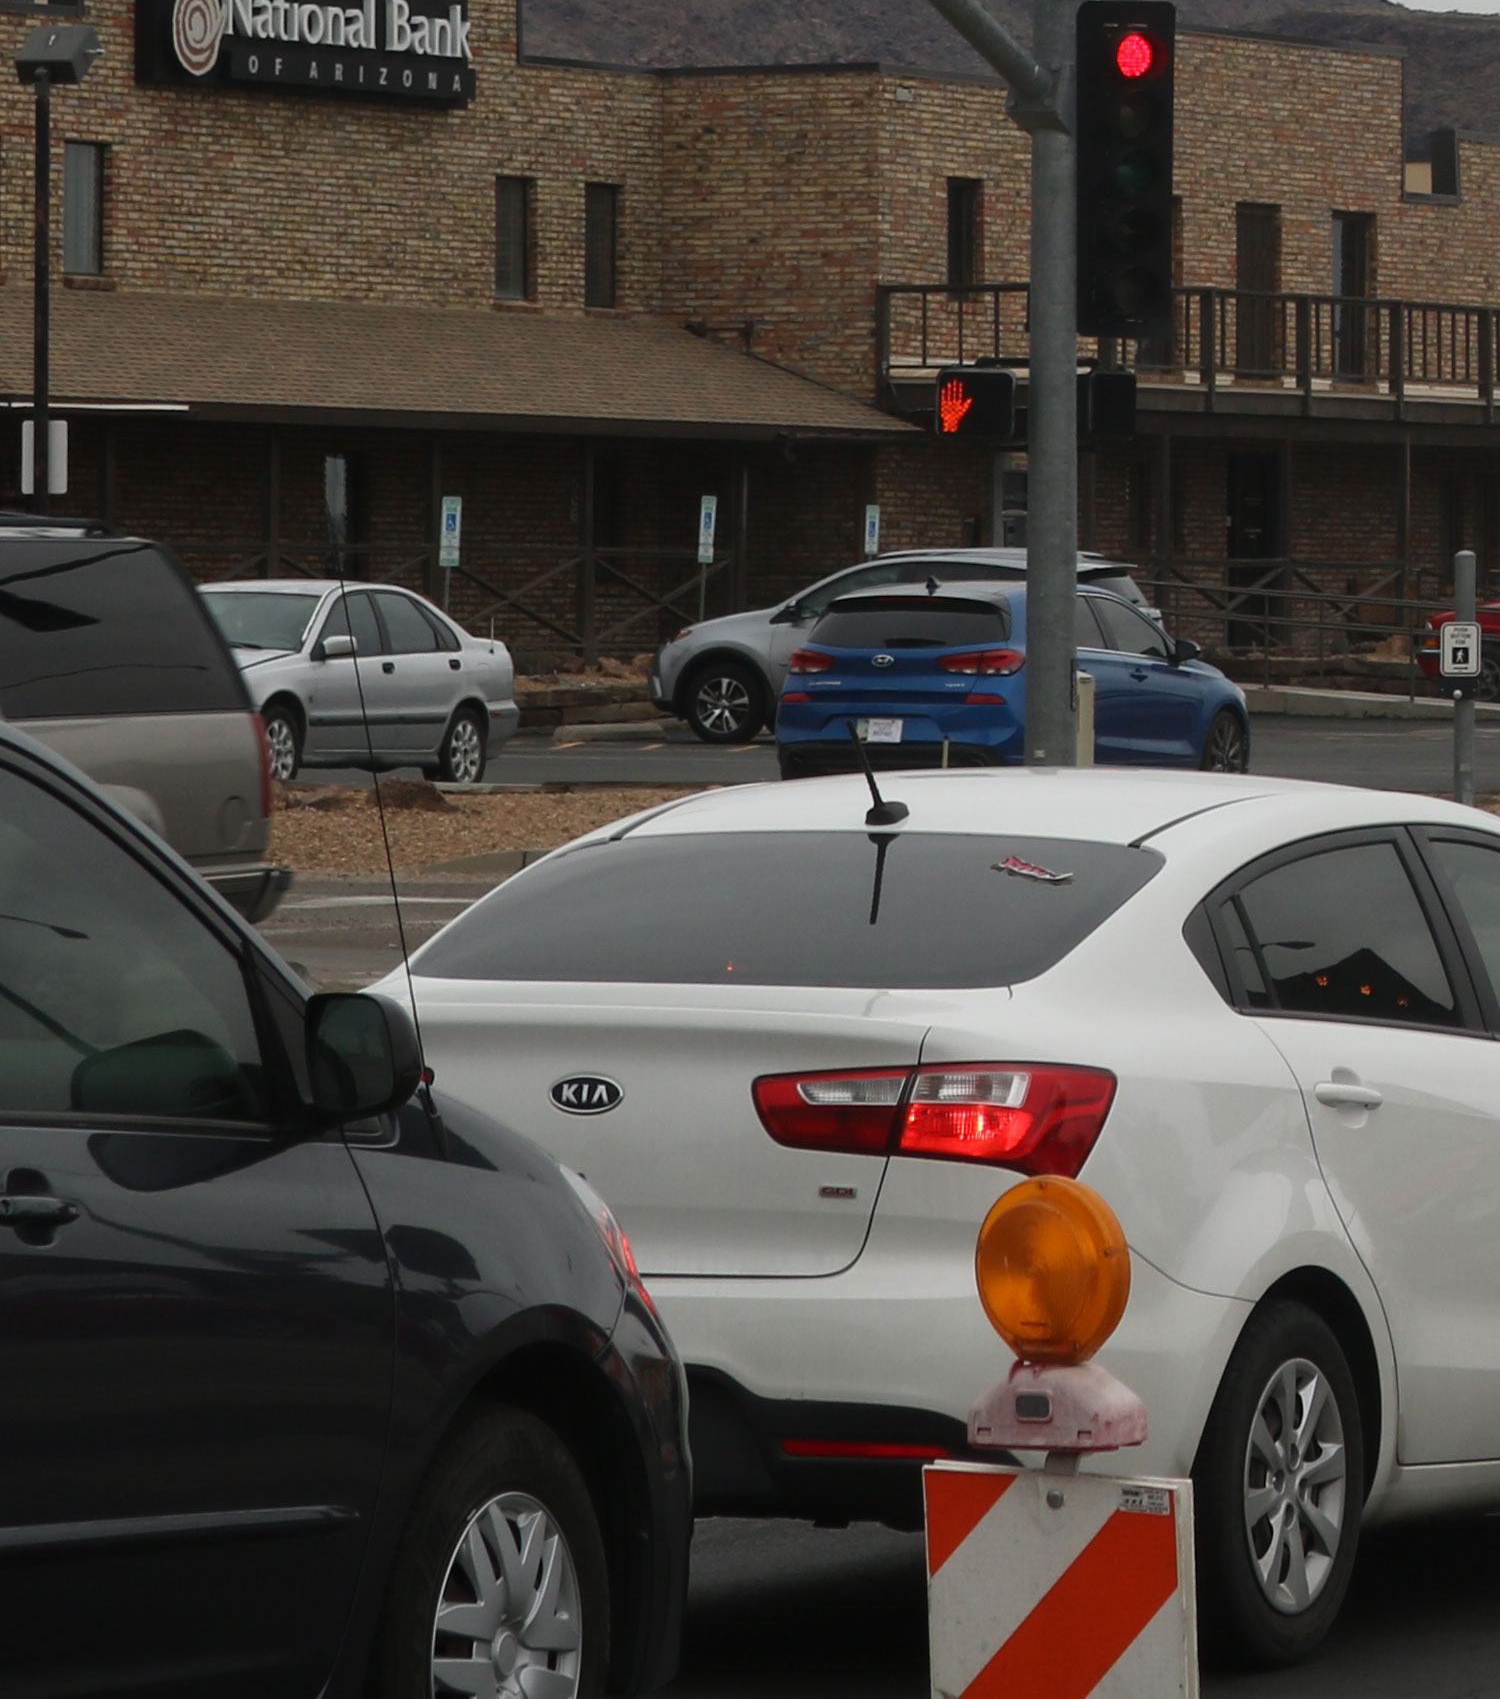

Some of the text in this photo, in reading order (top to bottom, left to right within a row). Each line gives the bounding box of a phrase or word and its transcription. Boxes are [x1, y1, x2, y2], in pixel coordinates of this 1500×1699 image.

[248, 54, 462, 92] OF ARIZONA
[561, 1083, 610, 1104] KIA
